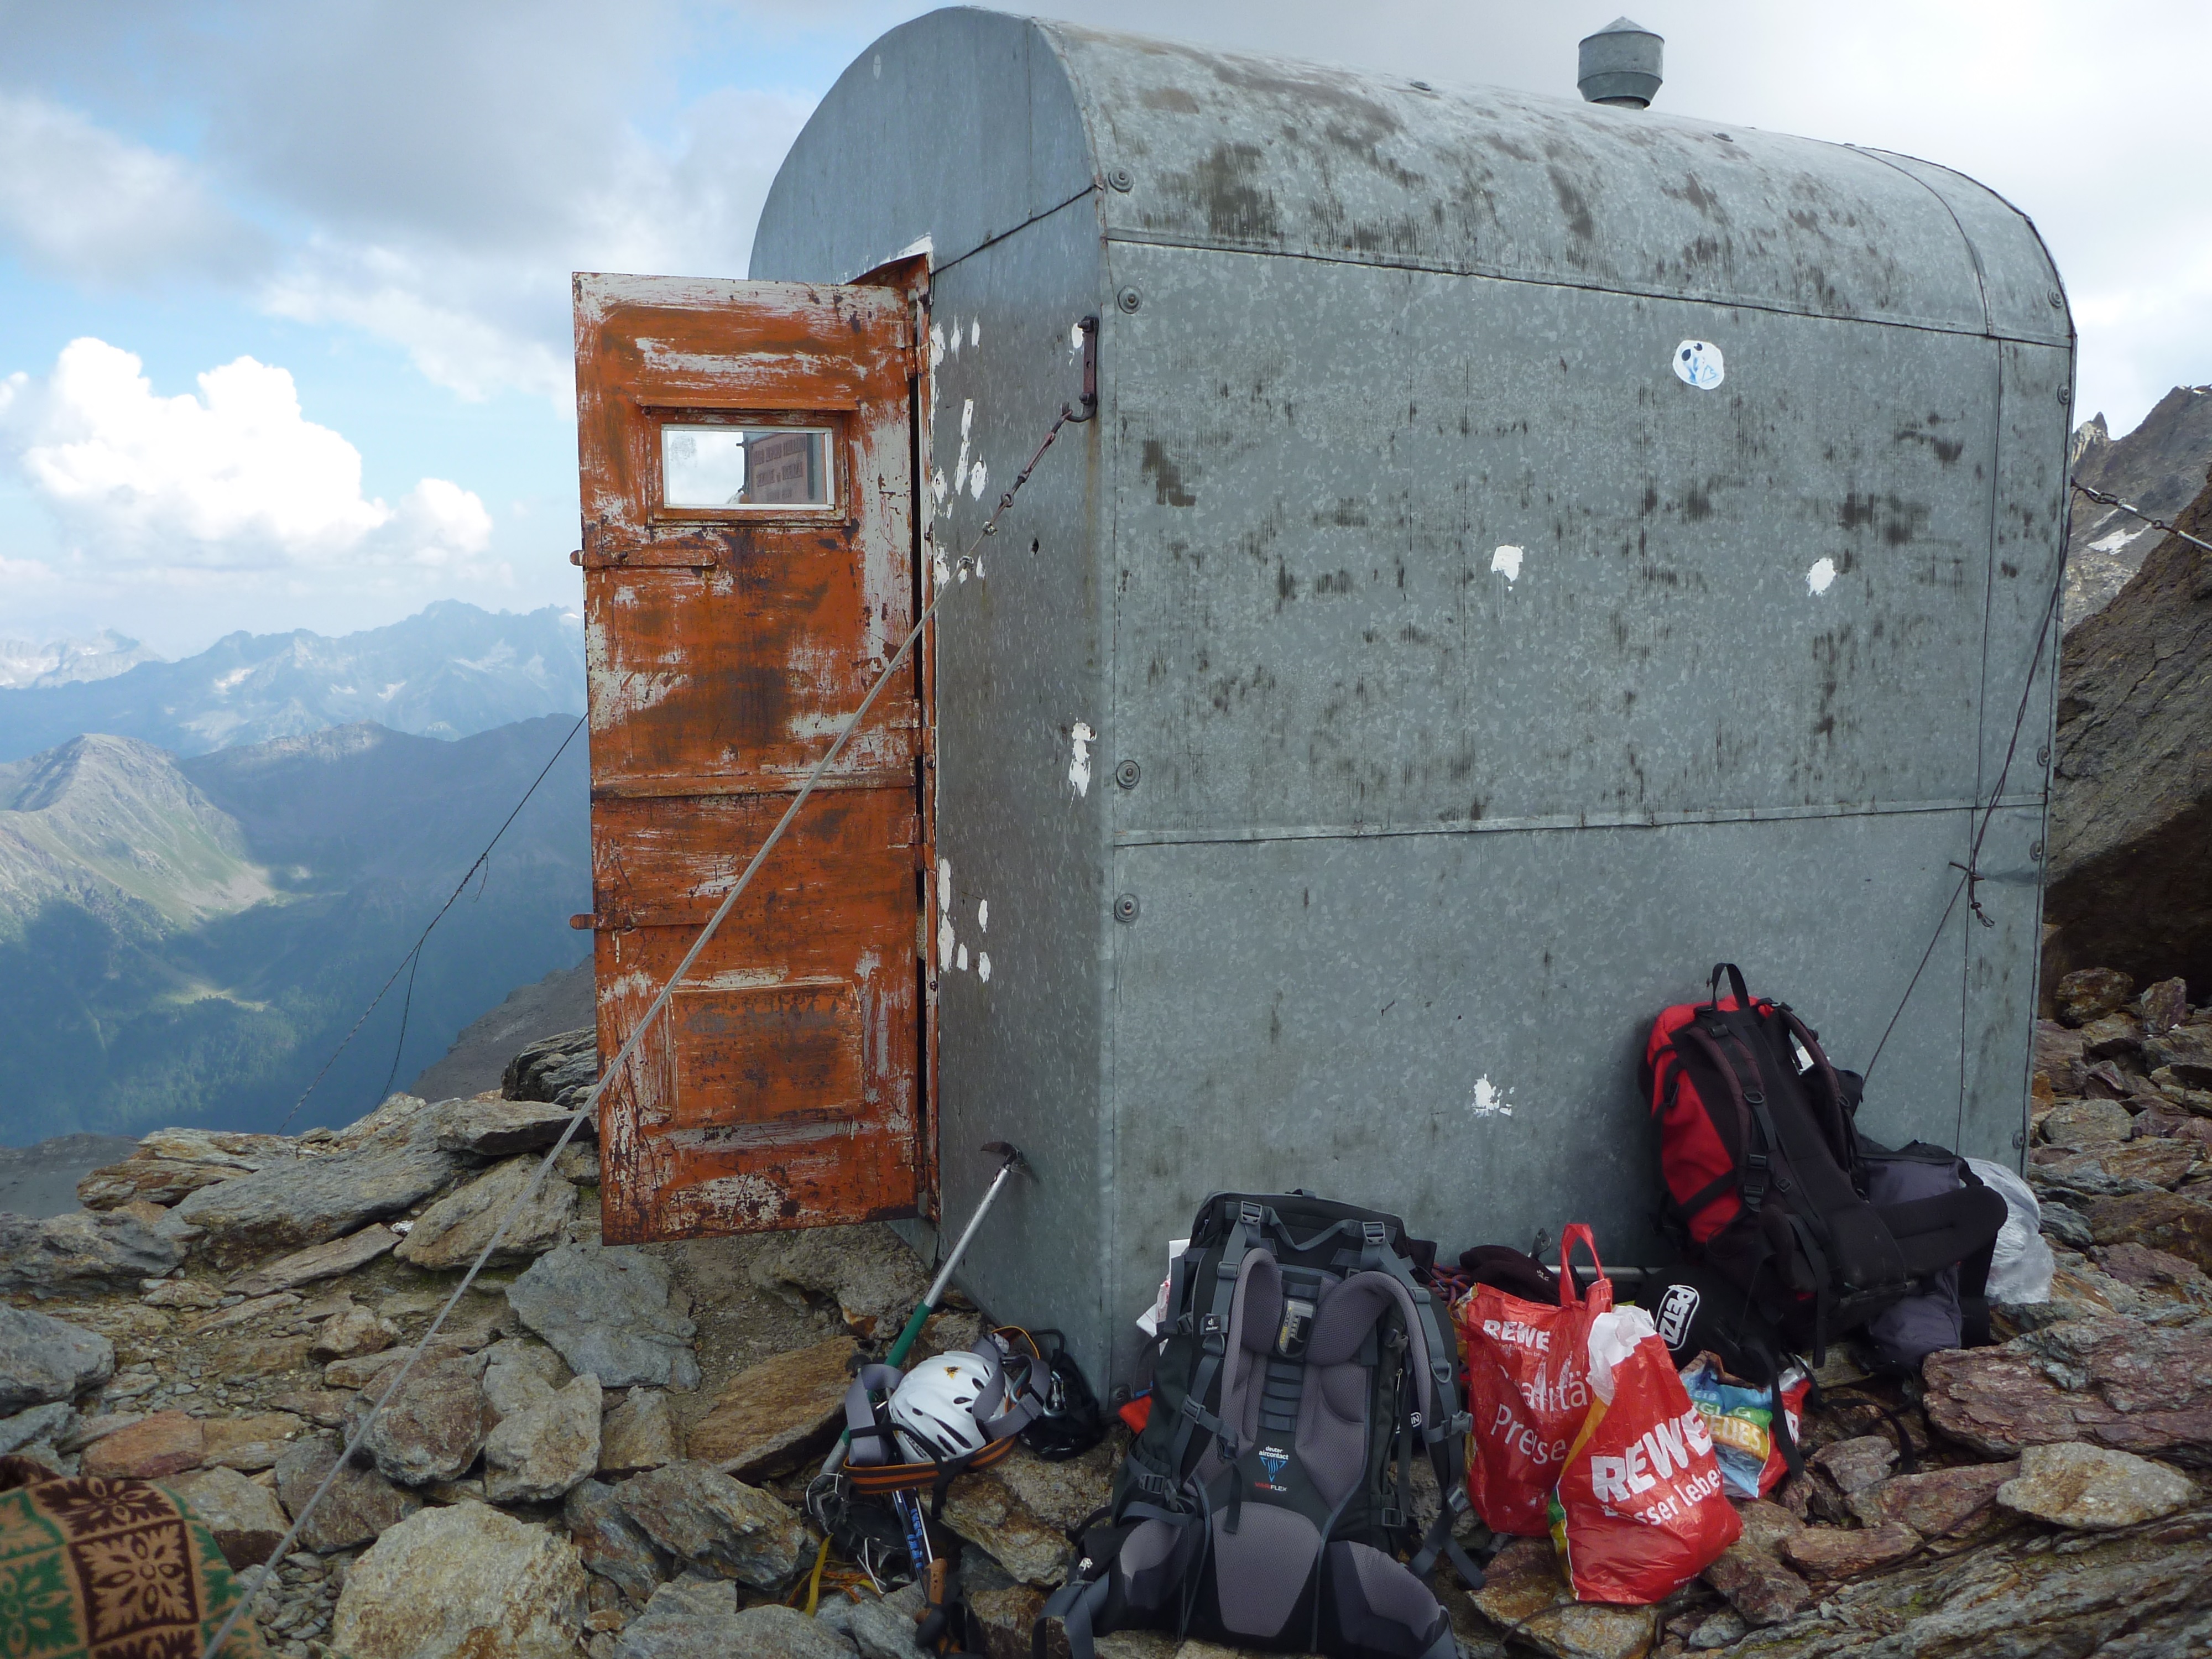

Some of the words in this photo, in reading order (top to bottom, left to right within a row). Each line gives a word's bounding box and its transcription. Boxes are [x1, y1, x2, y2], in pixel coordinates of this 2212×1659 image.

[1483, 1319, 1551, 1353] REWE
[1520, 1355, 1588, 1412] alitä
[1265, 1445, 1283, 1453] deuter
[1490, 1403, 1566, 1465] Preise
[1258, 1449, 1289, 1460] aircontact
[1590, 1406, 1713, 1503] REWE
[1673, 1467, 1721, 1507] lebe
